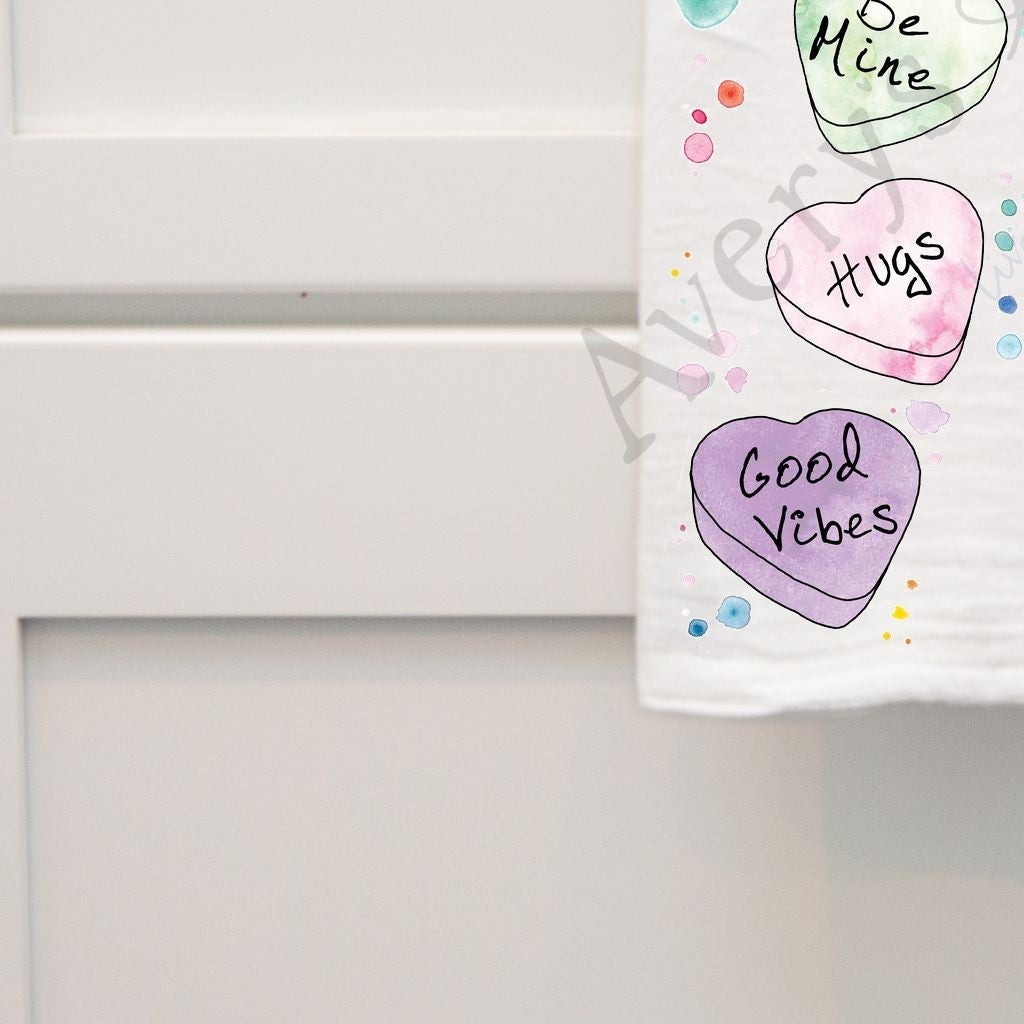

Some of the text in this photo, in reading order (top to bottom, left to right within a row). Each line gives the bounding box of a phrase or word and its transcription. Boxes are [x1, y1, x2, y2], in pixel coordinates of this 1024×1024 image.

[809, 15, 936, 91] Mine
[826, 231, 945, 308] Hugs
[739, 421, 869, 499] Good
[752, 504, 898, 553] Vibes
